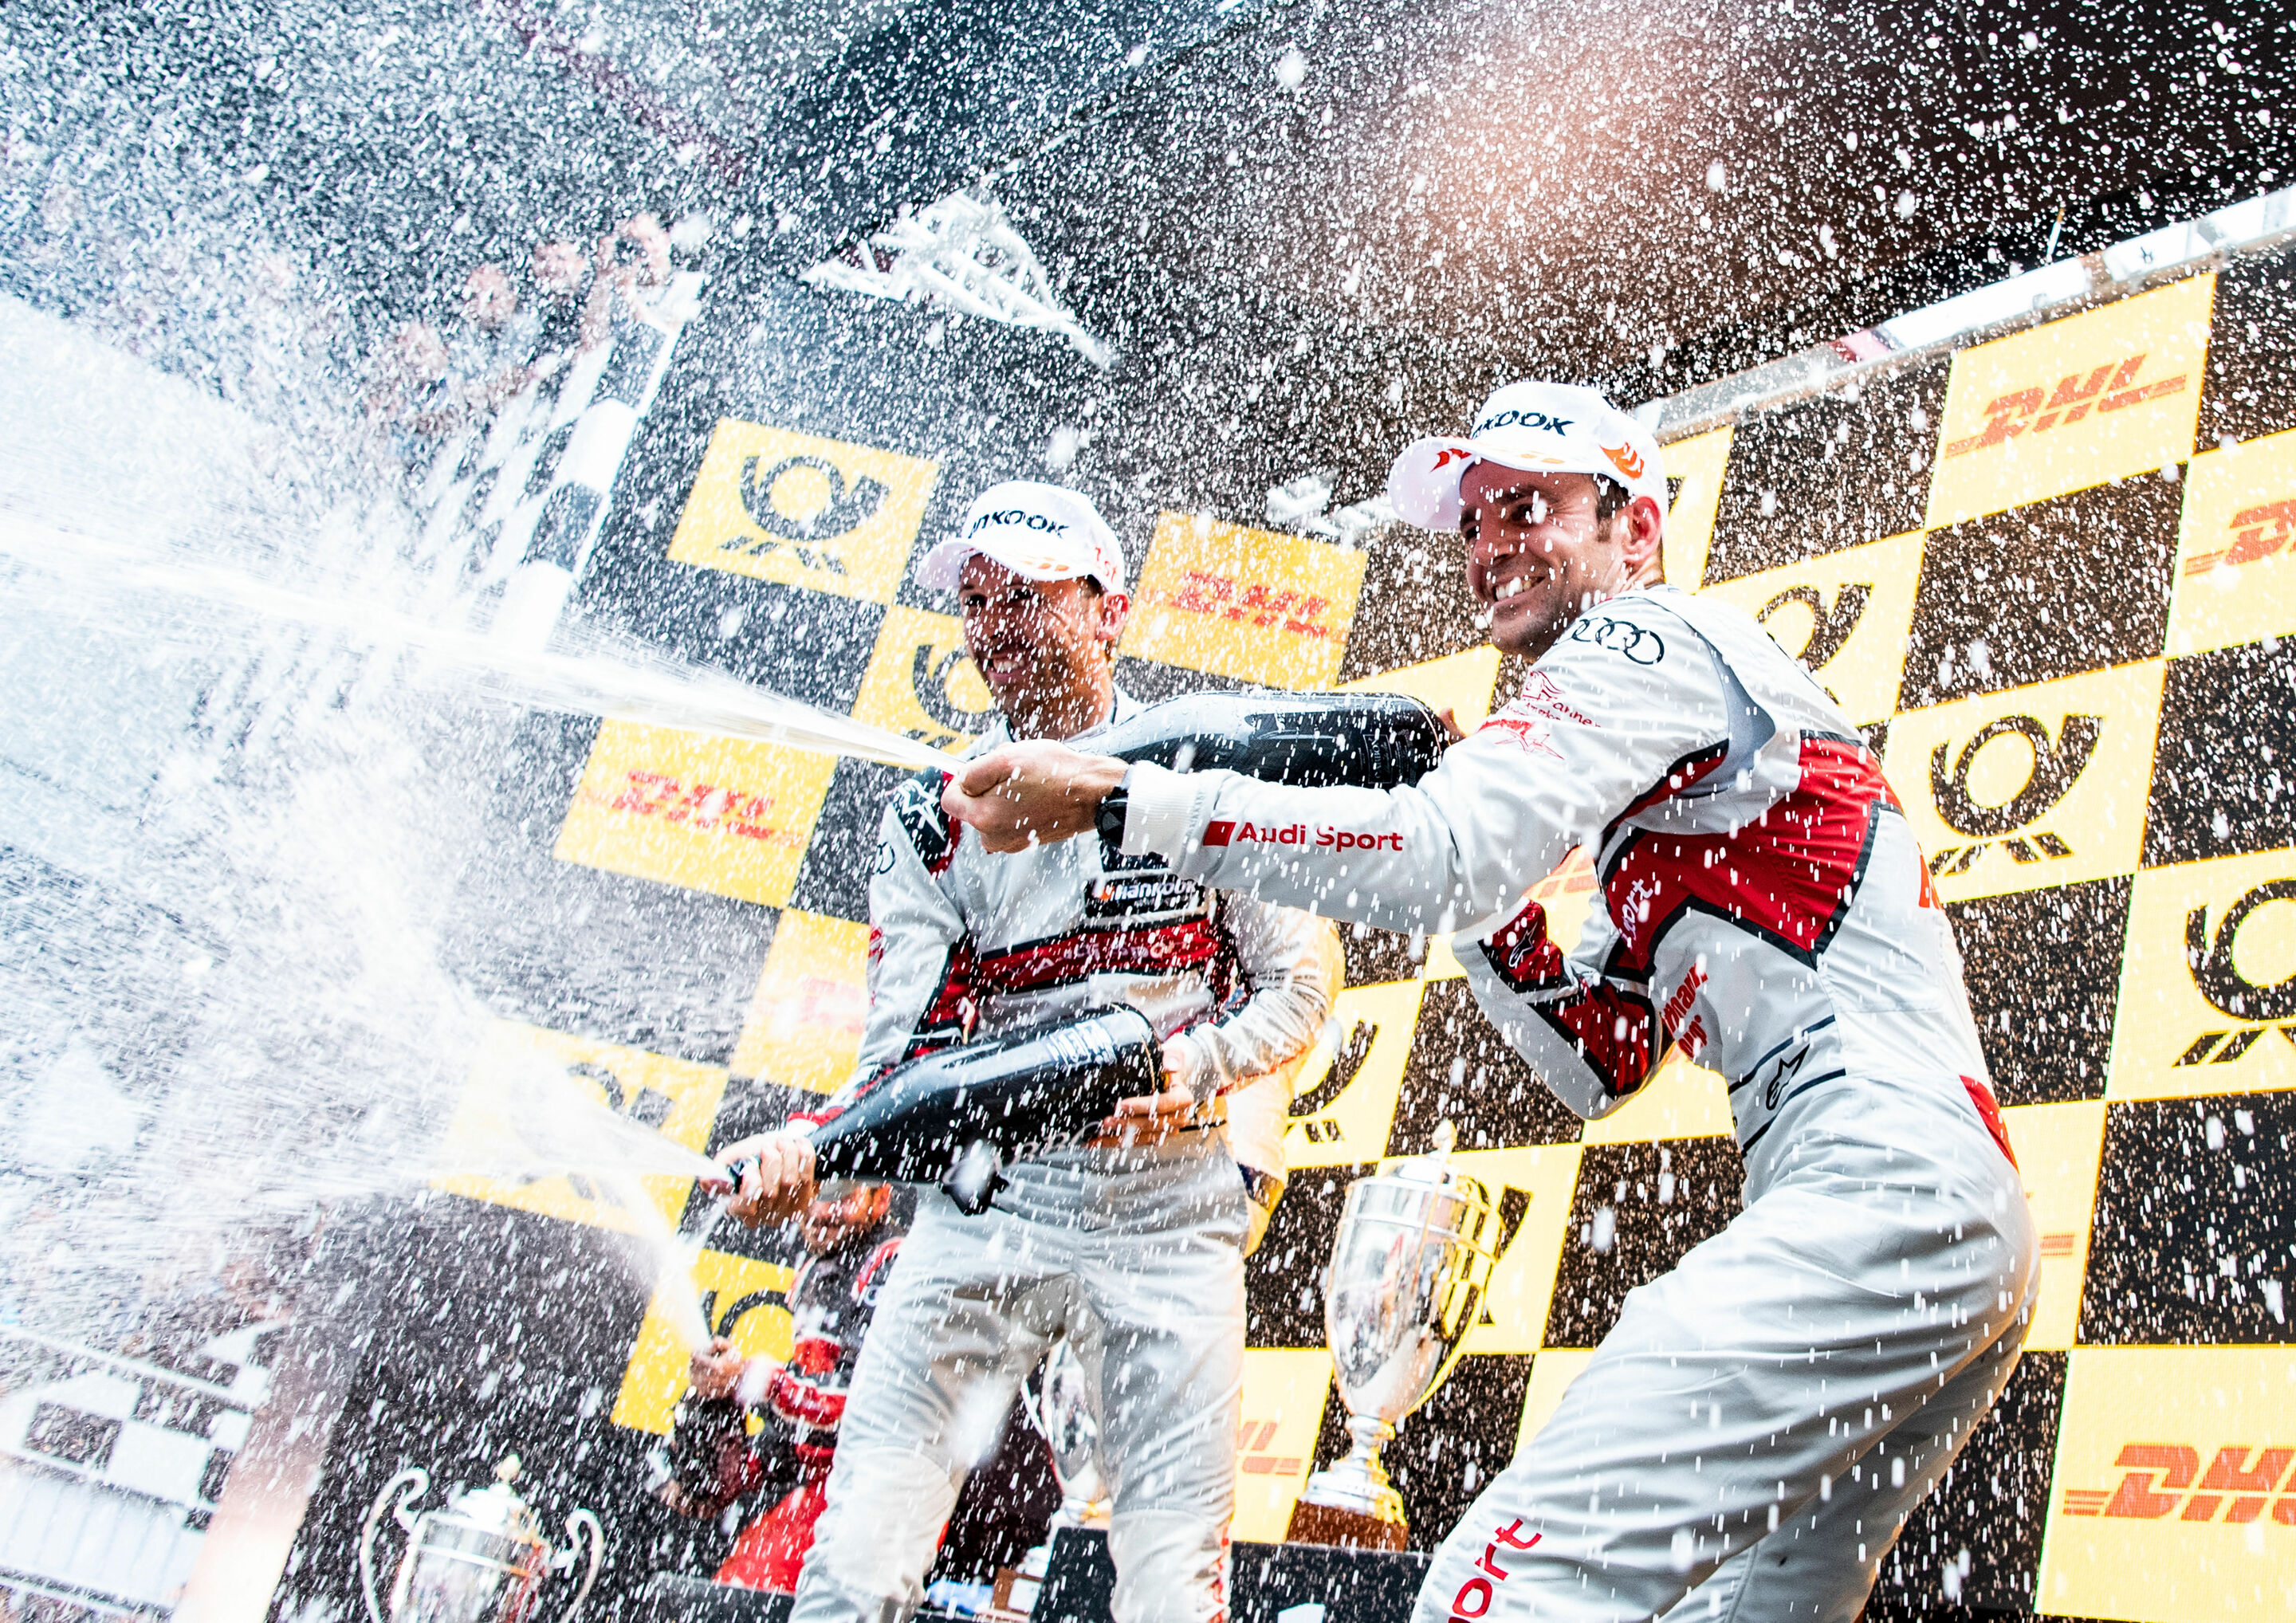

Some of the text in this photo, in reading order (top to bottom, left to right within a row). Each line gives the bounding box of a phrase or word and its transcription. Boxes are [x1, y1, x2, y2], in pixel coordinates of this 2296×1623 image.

[1972, 353, 2151, 449] DHL
[1170, 569, 1329, 639] DHL
[611, 769, 776, 840] DHL
[1236, 822, 1403, 852] Audi Sport
[1449, 1518, 1543, 1623] ort
